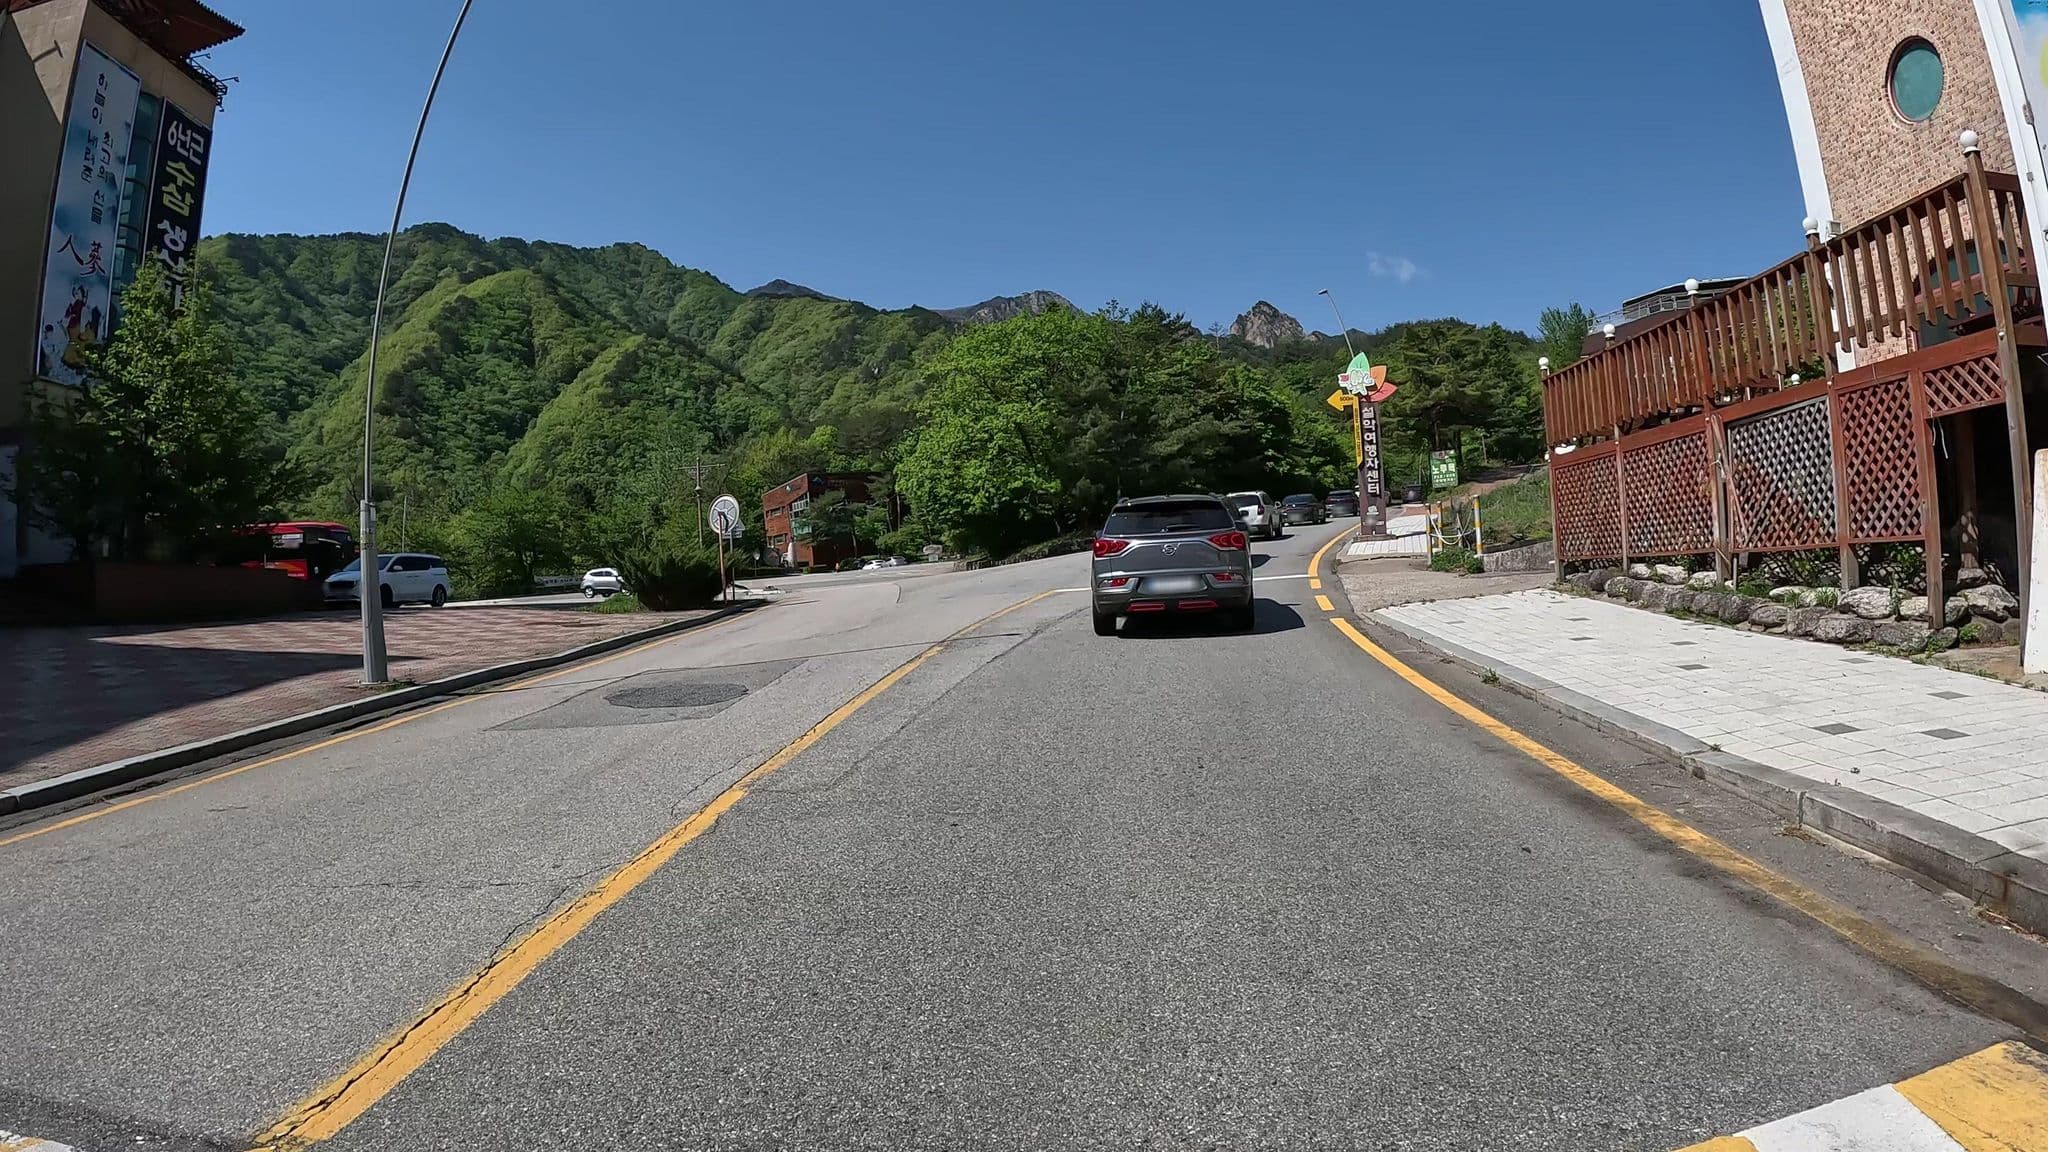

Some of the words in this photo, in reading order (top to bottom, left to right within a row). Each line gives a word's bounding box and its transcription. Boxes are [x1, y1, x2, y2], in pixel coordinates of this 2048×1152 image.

[92, 73, 108, 124] 하늘이
[167, 120, 204, 165] 6년근
[91, 189, 105, 224] 선물
[162, 160, 195, 217] 수삼
[1362, 406, 1380, 495] 설악여행자센터
